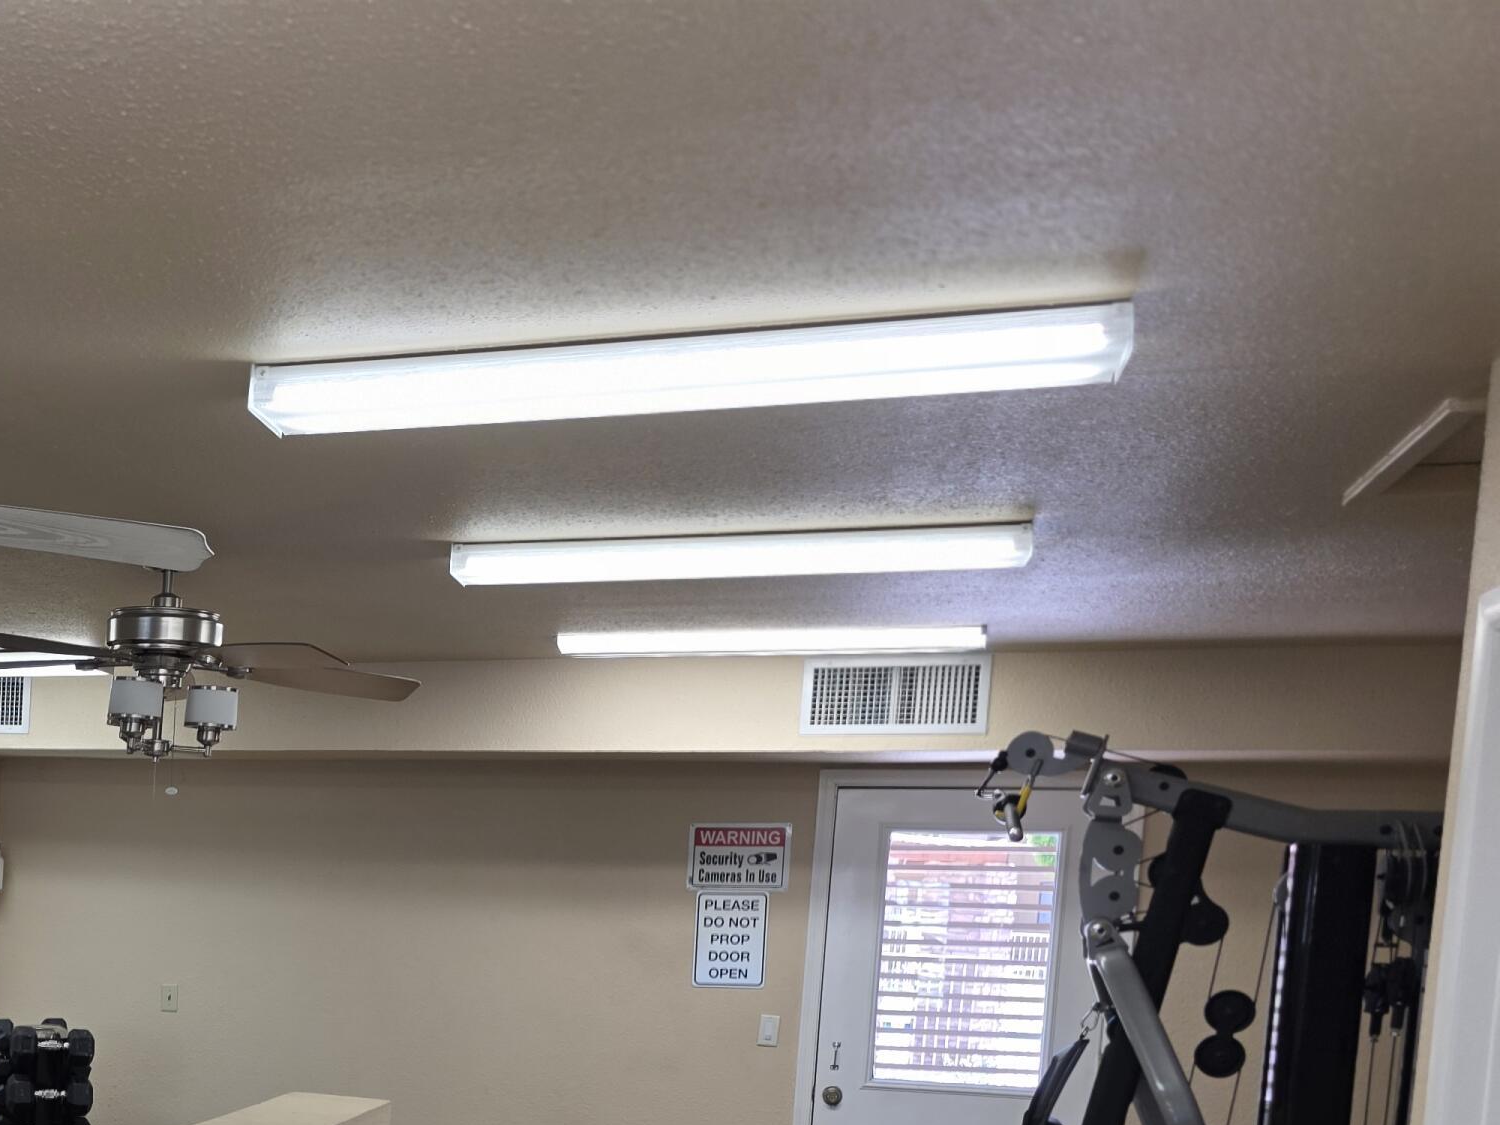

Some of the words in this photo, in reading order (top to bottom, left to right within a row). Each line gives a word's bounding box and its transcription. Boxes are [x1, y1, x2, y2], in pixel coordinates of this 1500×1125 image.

[700, 830, 781, 845] WARNING
[699, 851, 744, 868] Security
[698, 868, 742, 883] Cameras
[745, 869, 755, 883] In
[758, 869, 777, 883] Use
[704, 899, 760, 911] PLEASE
[703, 916, 725, 928] DO
[728, 916, 759, 928] NOT
[710, 933, 750, 945] PROP
[708, 950, 750, 962] DOOR
[708, 968, 748, 979] OPEN
